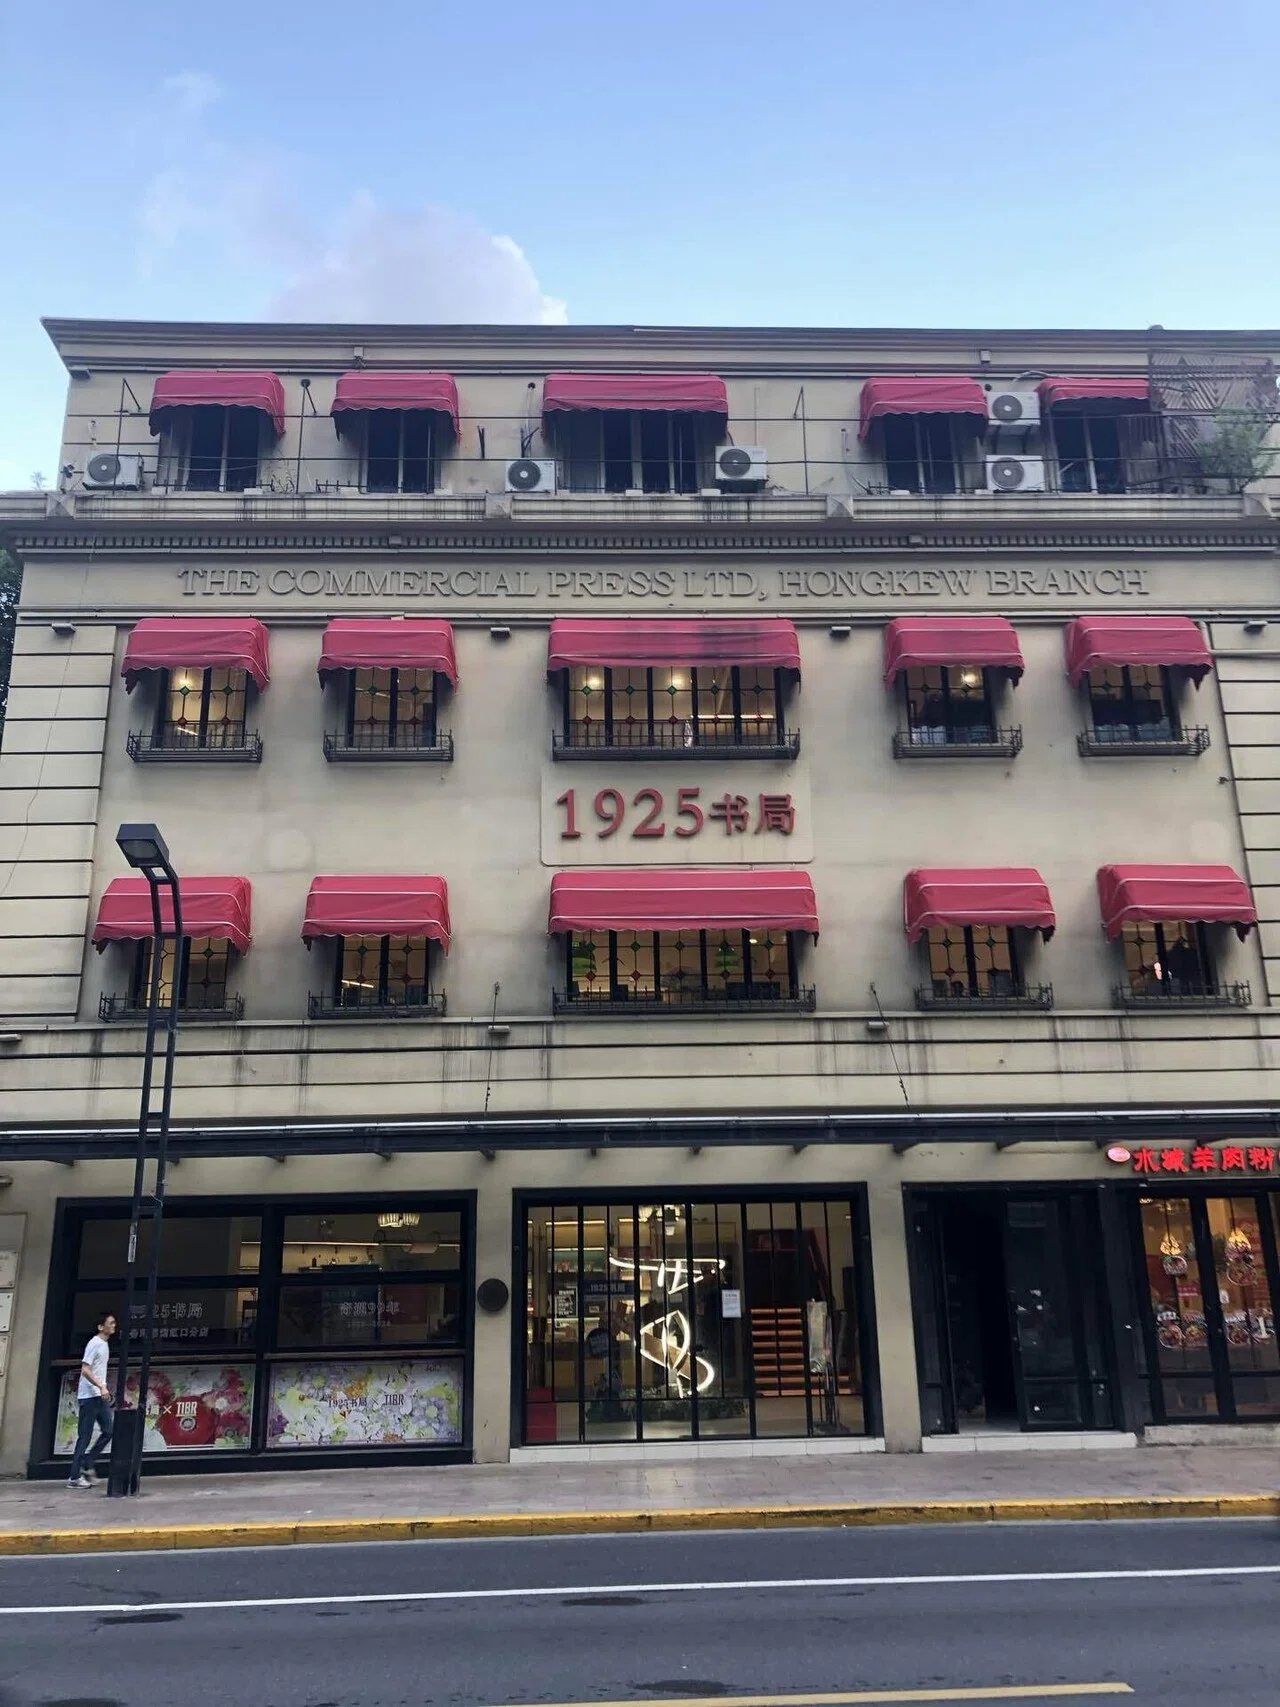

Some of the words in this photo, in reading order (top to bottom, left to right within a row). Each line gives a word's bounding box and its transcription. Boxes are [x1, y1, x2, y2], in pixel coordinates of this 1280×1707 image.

[177, 568, 260, 596] THE
[267, 568, 540, 597] COMMERCIAL
[548, 570, 676, 597] PRESS
[778, 569, 978, 597] HONGKEW
[986, 569, 1150, 597] BRANCH
[556, 787, 796, 840] 1925书局
